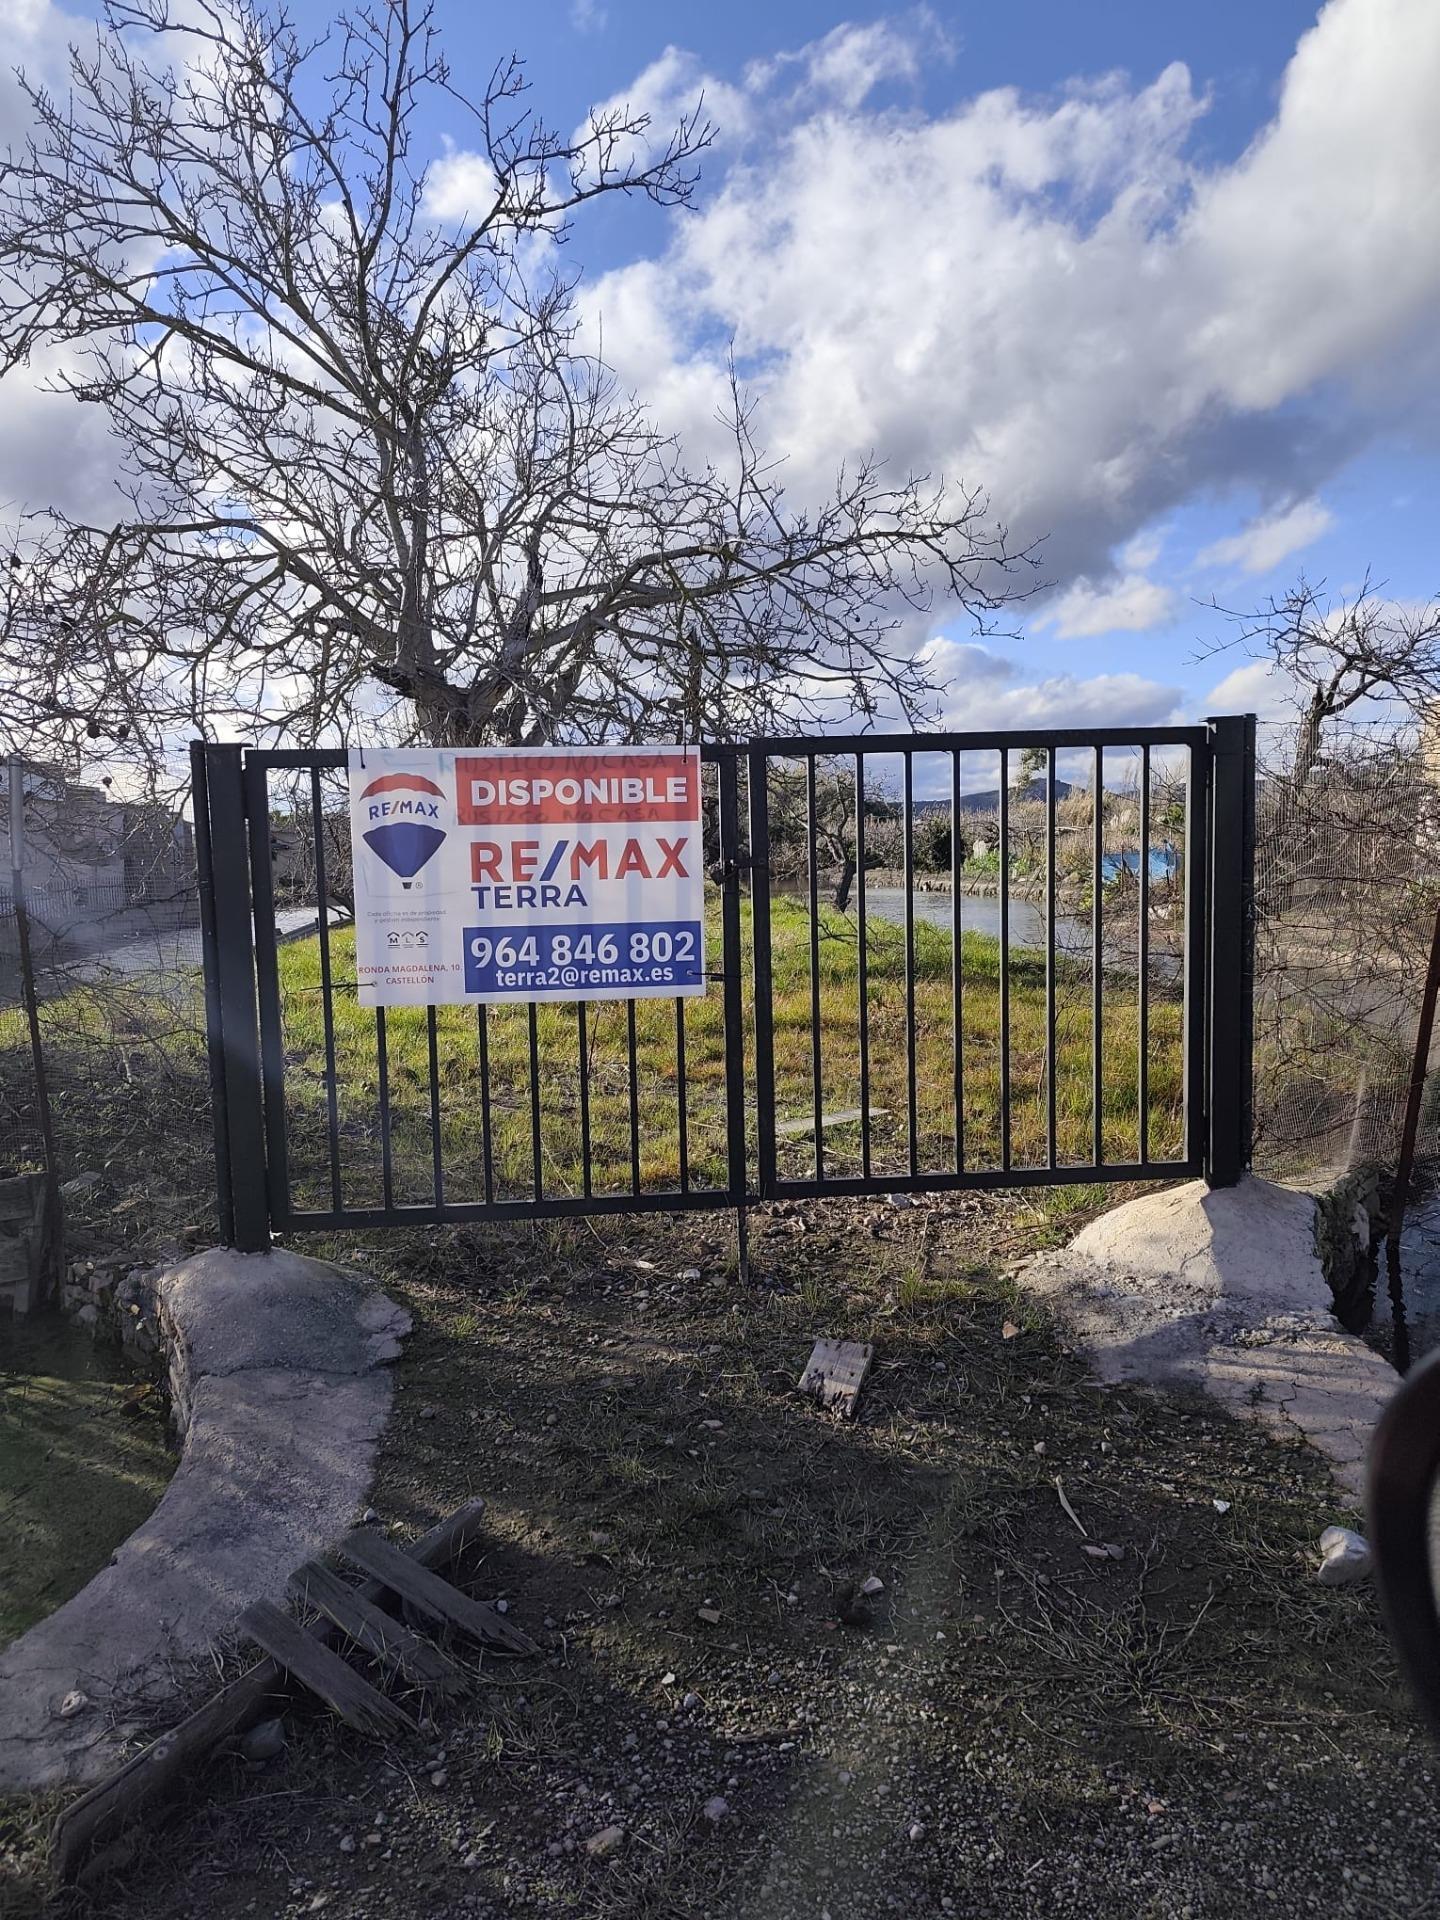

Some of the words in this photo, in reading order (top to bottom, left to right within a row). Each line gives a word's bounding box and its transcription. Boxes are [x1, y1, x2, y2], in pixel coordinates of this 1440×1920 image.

[471, 778, 687, 806] DISPONIBLE
[369, 800, 439, 820] RE/MAX
[470, 838, 690, 883] RE/MAX
[471, 884, 588, 909] TERRA
[471, 937, 540, 968] 964
[551, 934, 619, 965] 846
[629, 931, 695, 963] 802
[358, 966, 390, 974] RONDA
[385, 975, 434, 985] CASTELLÓN
[496, 966, 673, 987] terra2@remax.es
